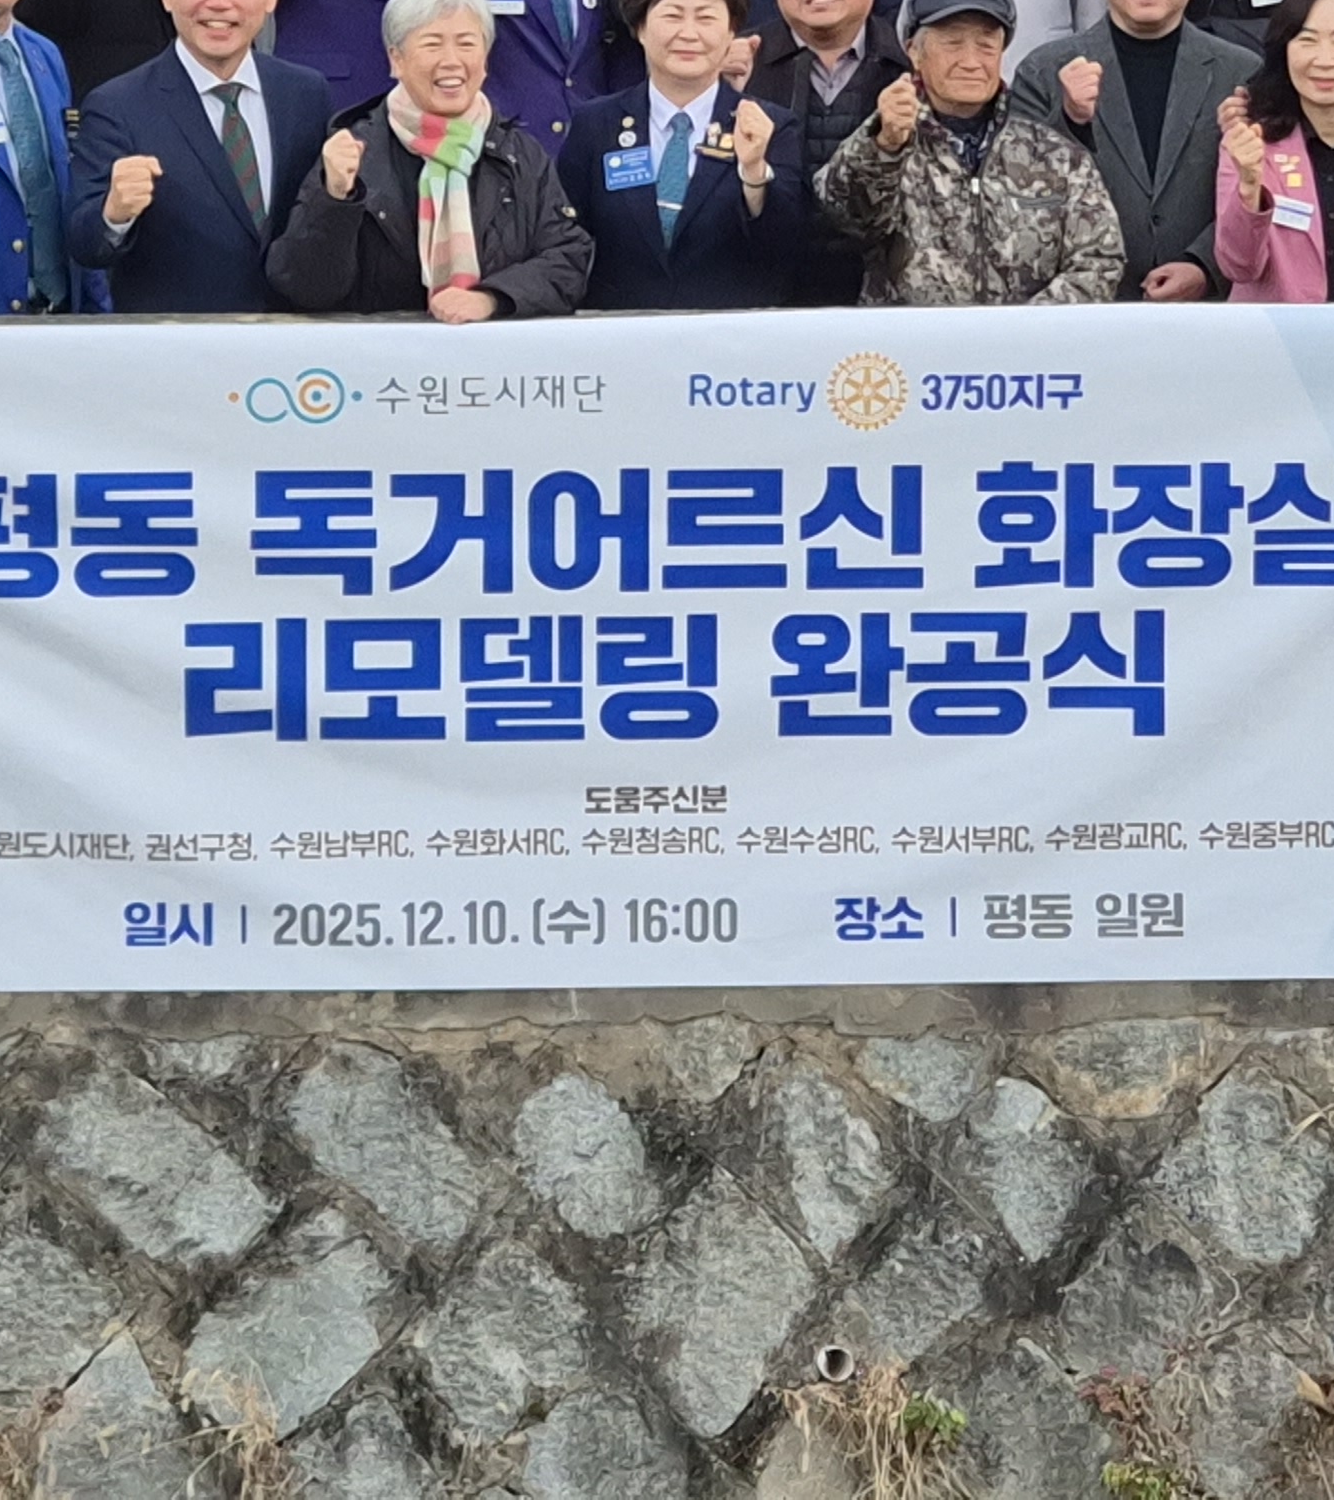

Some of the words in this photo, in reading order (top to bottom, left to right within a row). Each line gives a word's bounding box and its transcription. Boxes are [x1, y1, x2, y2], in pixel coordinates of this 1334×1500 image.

[375, 375, 607, 414] 수원도시재단
[689, 374, 817, 413] Rotary
[921, 373, 1084, 411] 3750지구
[249, 465, 924, 596] 독거어르신
[182, 613, 721, 743] 리모델링
[770, 609, 1167, 738] 완공식
[584, 785, 728, 814] 도움주신분
[145, 832, 258, 862] 권선구청,
[270, 830, 415, 860] 수원남부RC,
[426, 828, 570, 857] 수원화서RC,
[582, 826, 725, 856] 수원청송RC,
[736, 826, 880, 855] 수원수성RC,
[892, 825, 1035, 854] 수원서부RC,
[1045, 822, 1188, 852] 수원광교RC,
[124, 902, 214, 947] 일시
[625, 898, 738, 943] 16:00
[835, 896, 925, 942] 장소
[983, 894, 1073, 940] 평동
[1096, 893, 1185, 938] 일원
